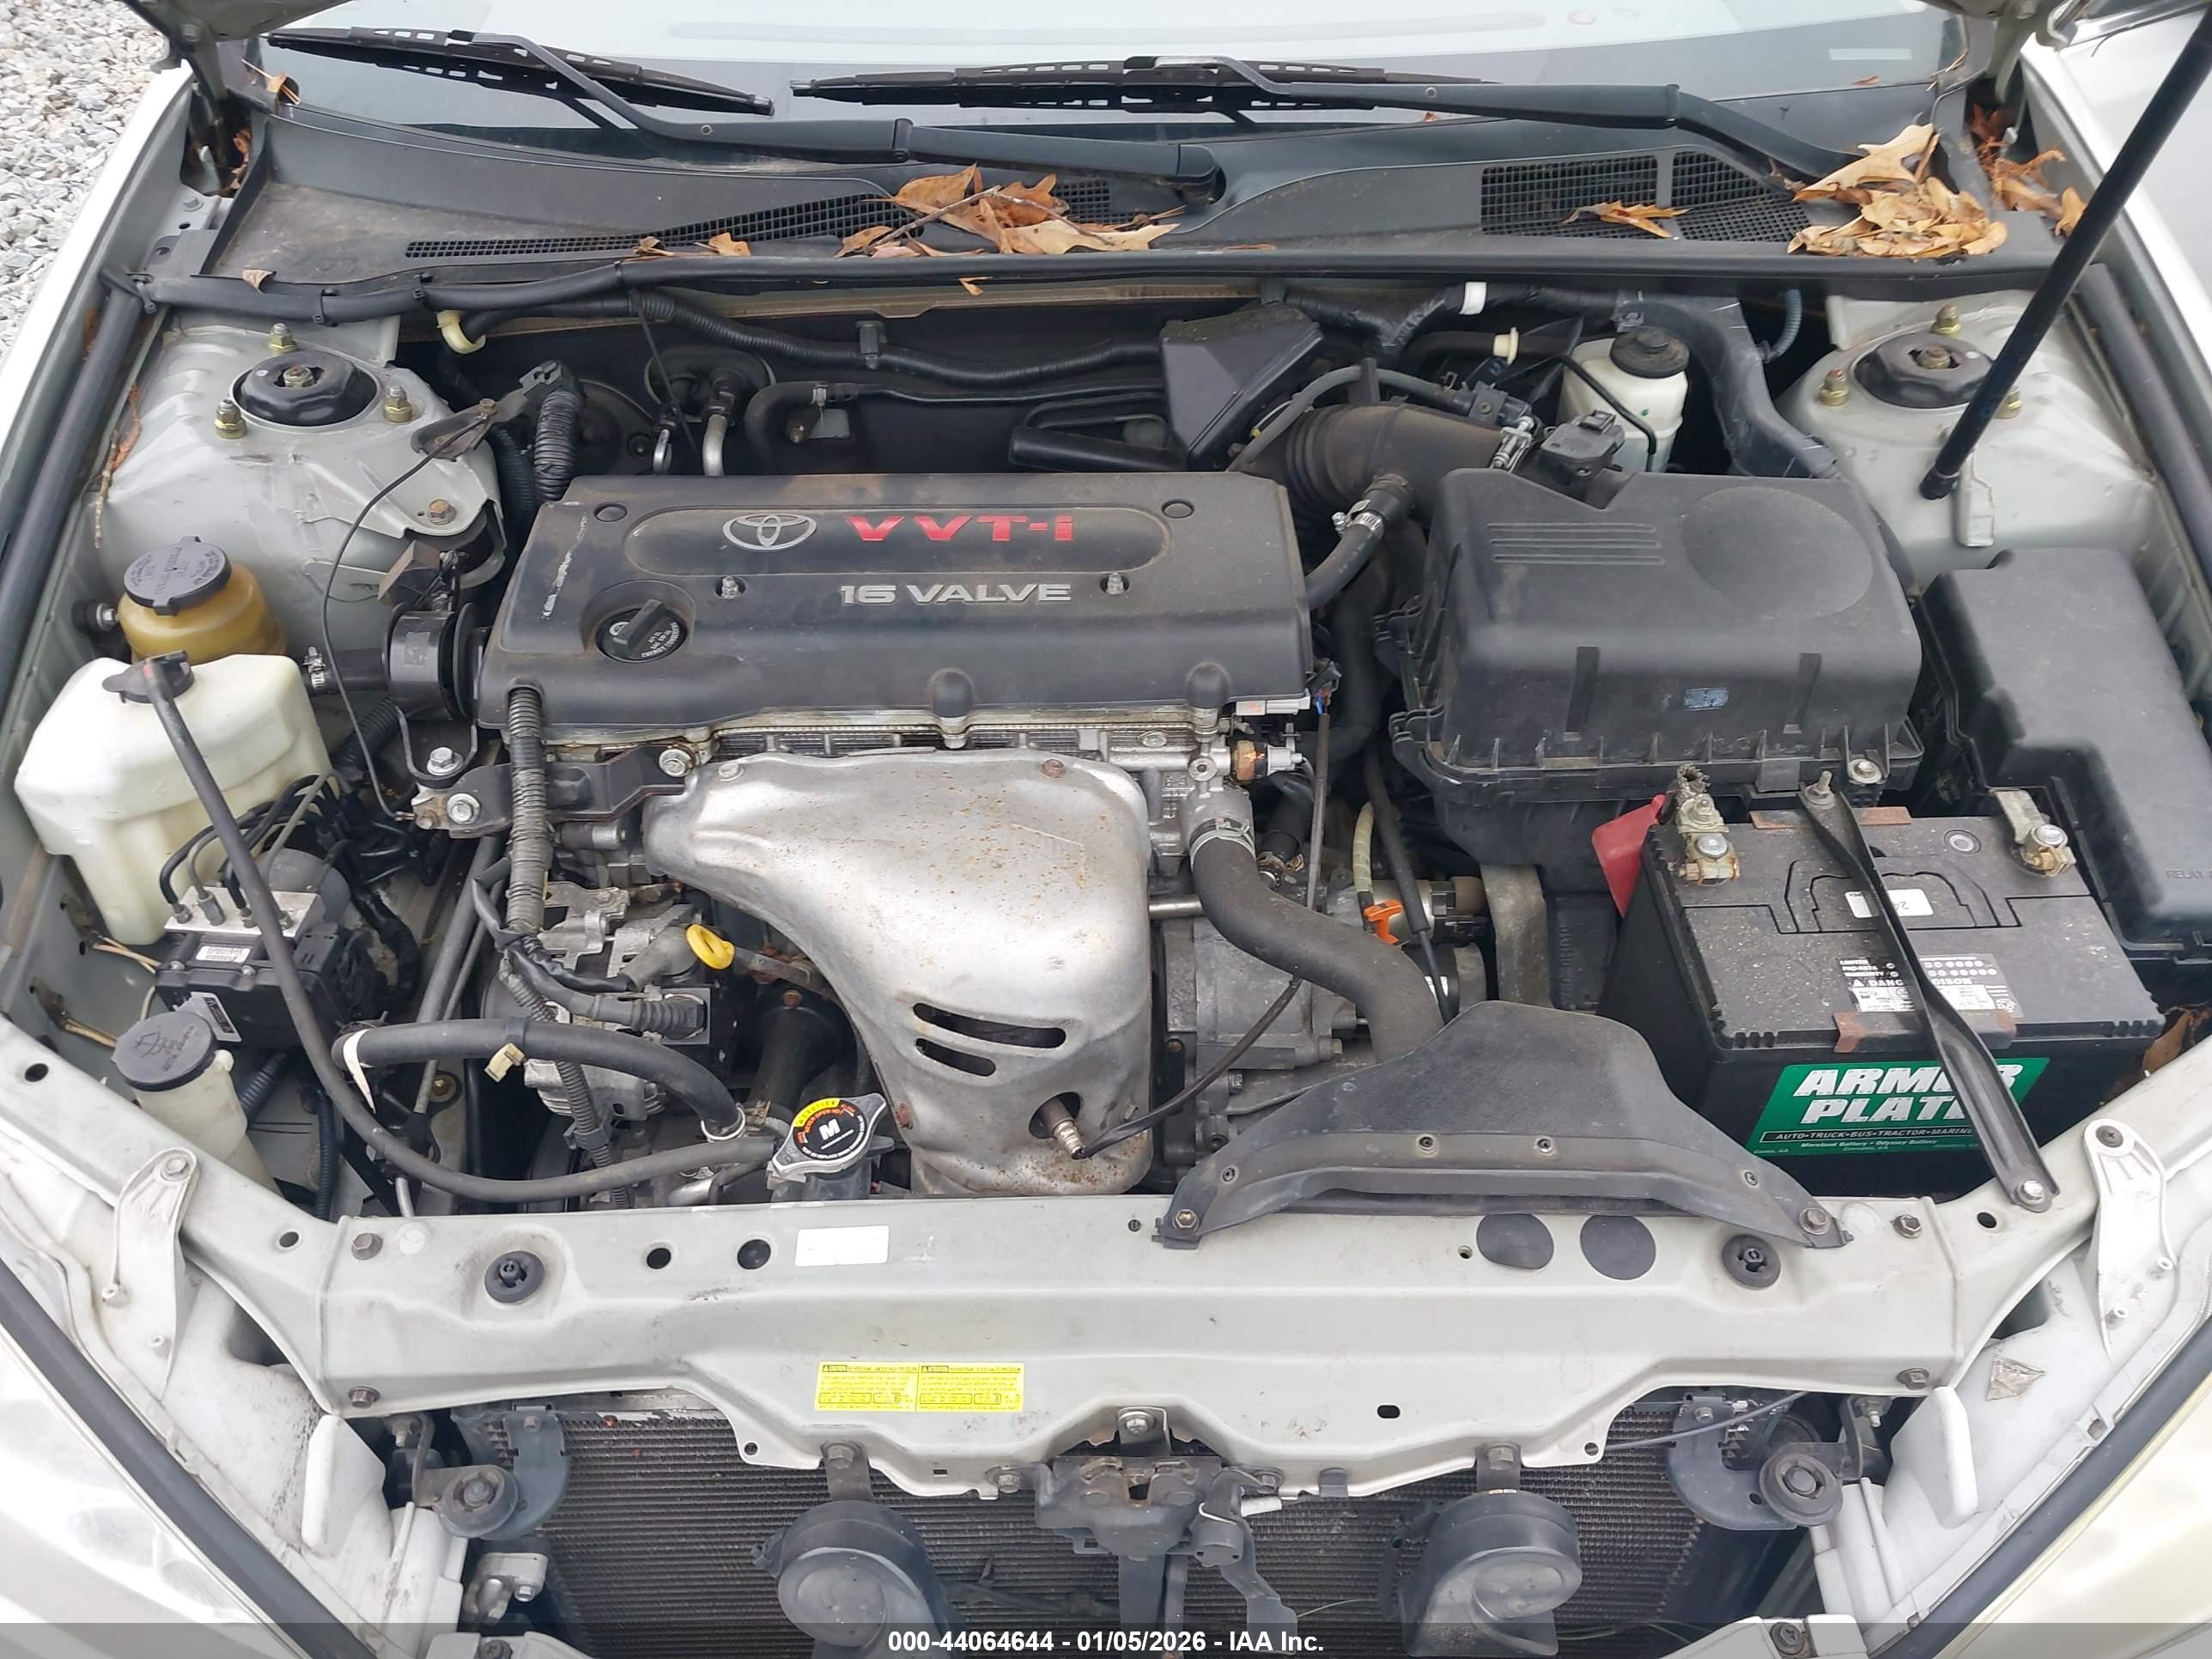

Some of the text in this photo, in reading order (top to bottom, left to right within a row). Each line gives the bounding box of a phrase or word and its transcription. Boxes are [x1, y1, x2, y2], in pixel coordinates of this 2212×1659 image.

[841, 584, 1072, 603] 16 VALVE
[1868, 979, 1905, 988] DANG
[818, 1118, 841, 1141] M
